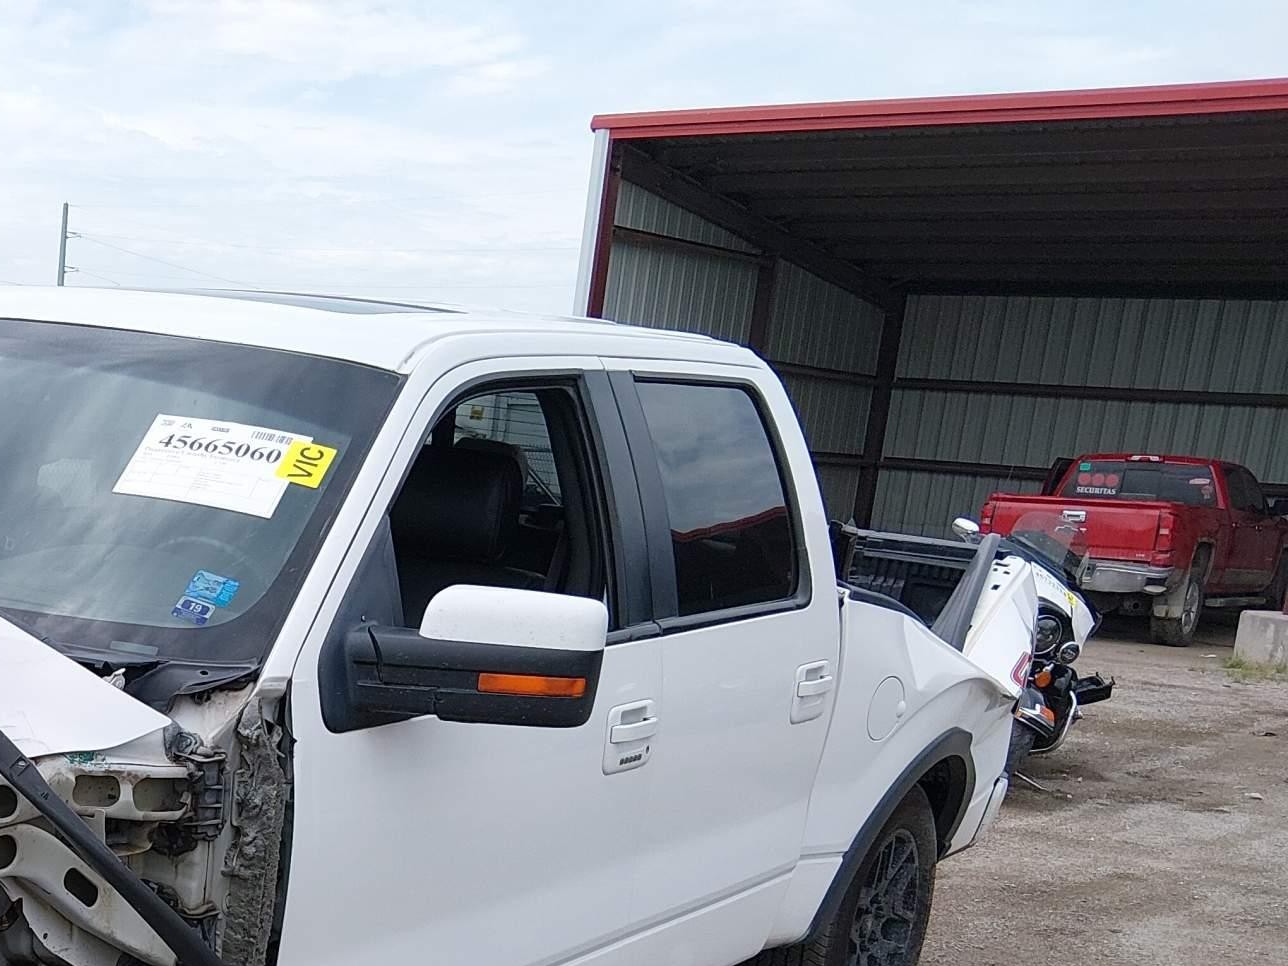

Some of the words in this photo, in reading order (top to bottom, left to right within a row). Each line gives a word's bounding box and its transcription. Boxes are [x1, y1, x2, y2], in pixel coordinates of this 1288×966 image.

[158, 433, 282, 464] 45665060
[286, 446, 325, 479] VIC
[1075, 485, 1118, 495] SECURITAS
[188, 602, 203, 613] 19
